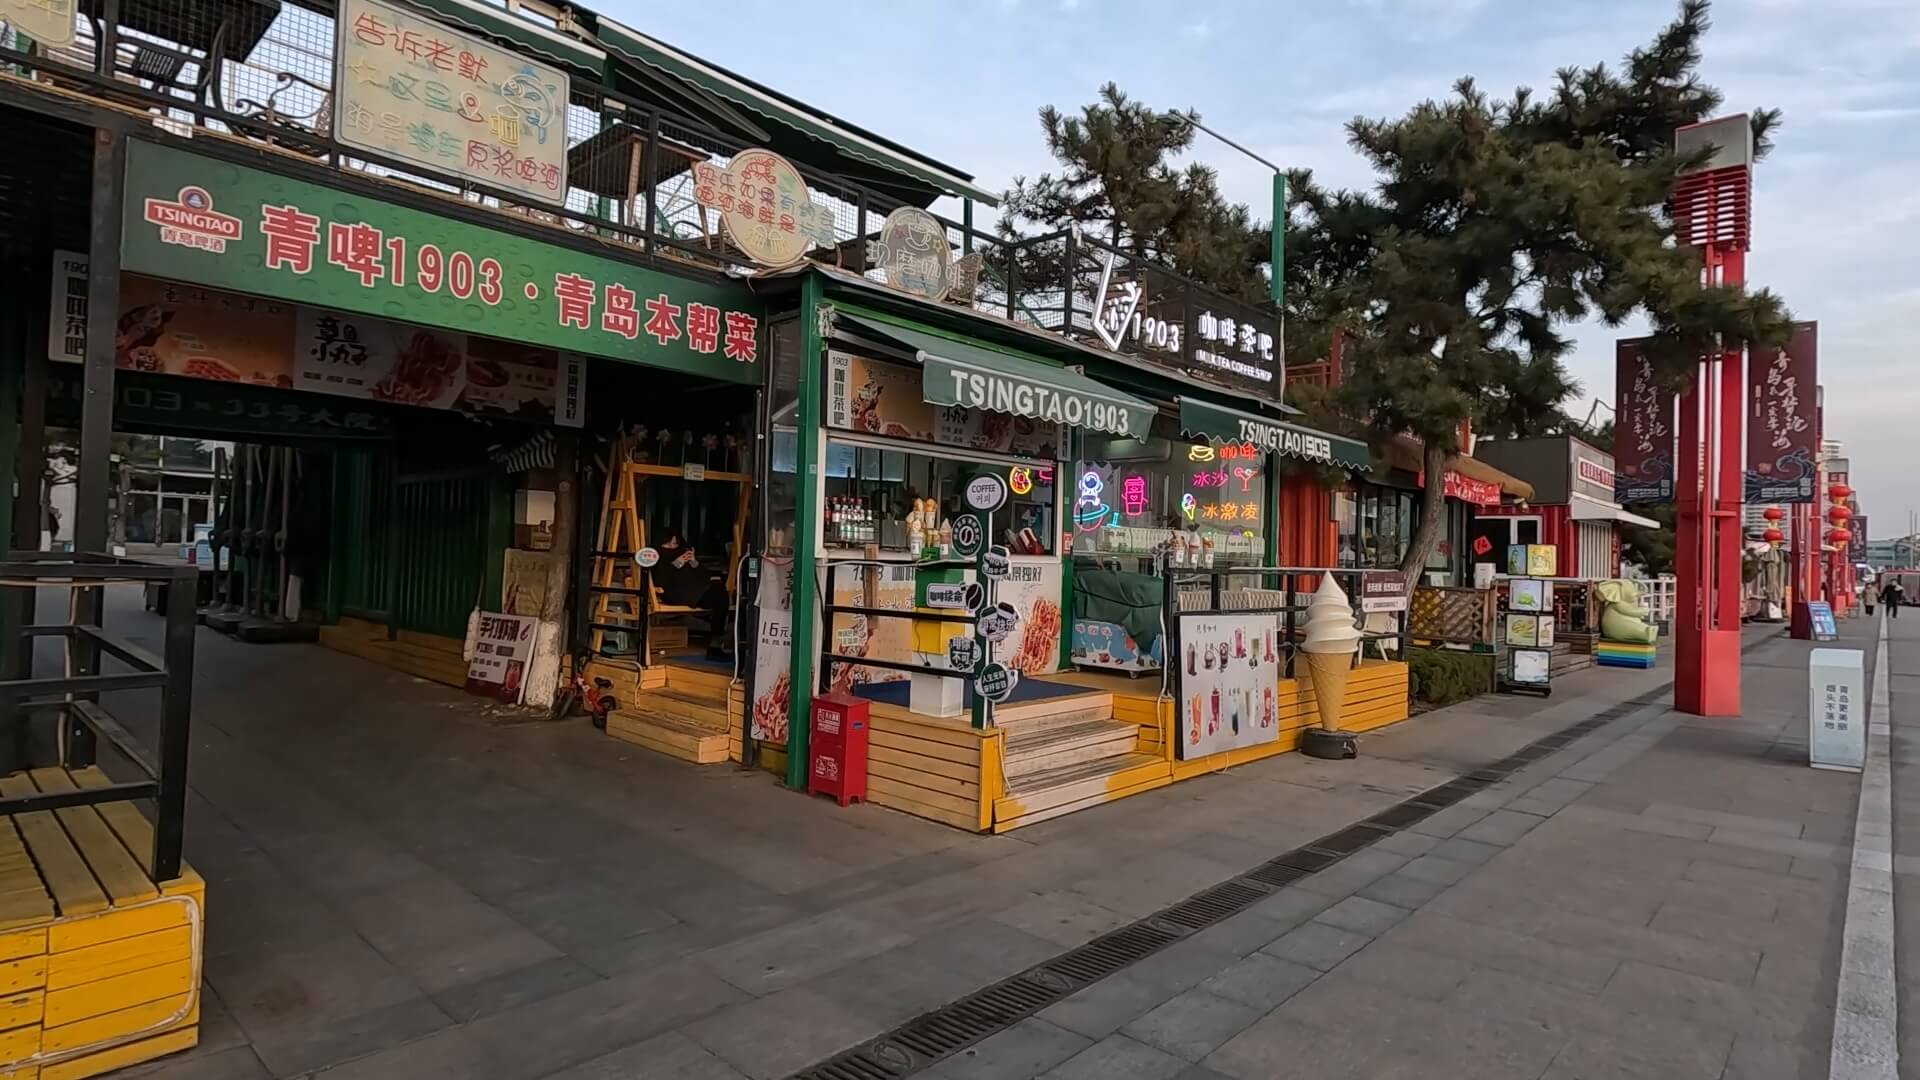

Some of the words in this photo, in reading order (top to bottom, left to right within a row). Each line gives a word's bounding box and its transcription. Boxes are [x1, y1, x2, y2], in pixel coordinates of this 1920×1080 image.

[153, 205, 236, 235] TSINGTAO
[62, 259, 89, 275] 190
[1132, 312, 1179, 352] 1903
[950, 369, 1130, 434] TSINGTAO1903
[1219, 443, 1257, 461] 咖啡
[1193, 470, 1229, 487] 冰沙
[971, 484, 997, 494] COFFEE
[1201, 501, 1260, 521] 冰激凌
